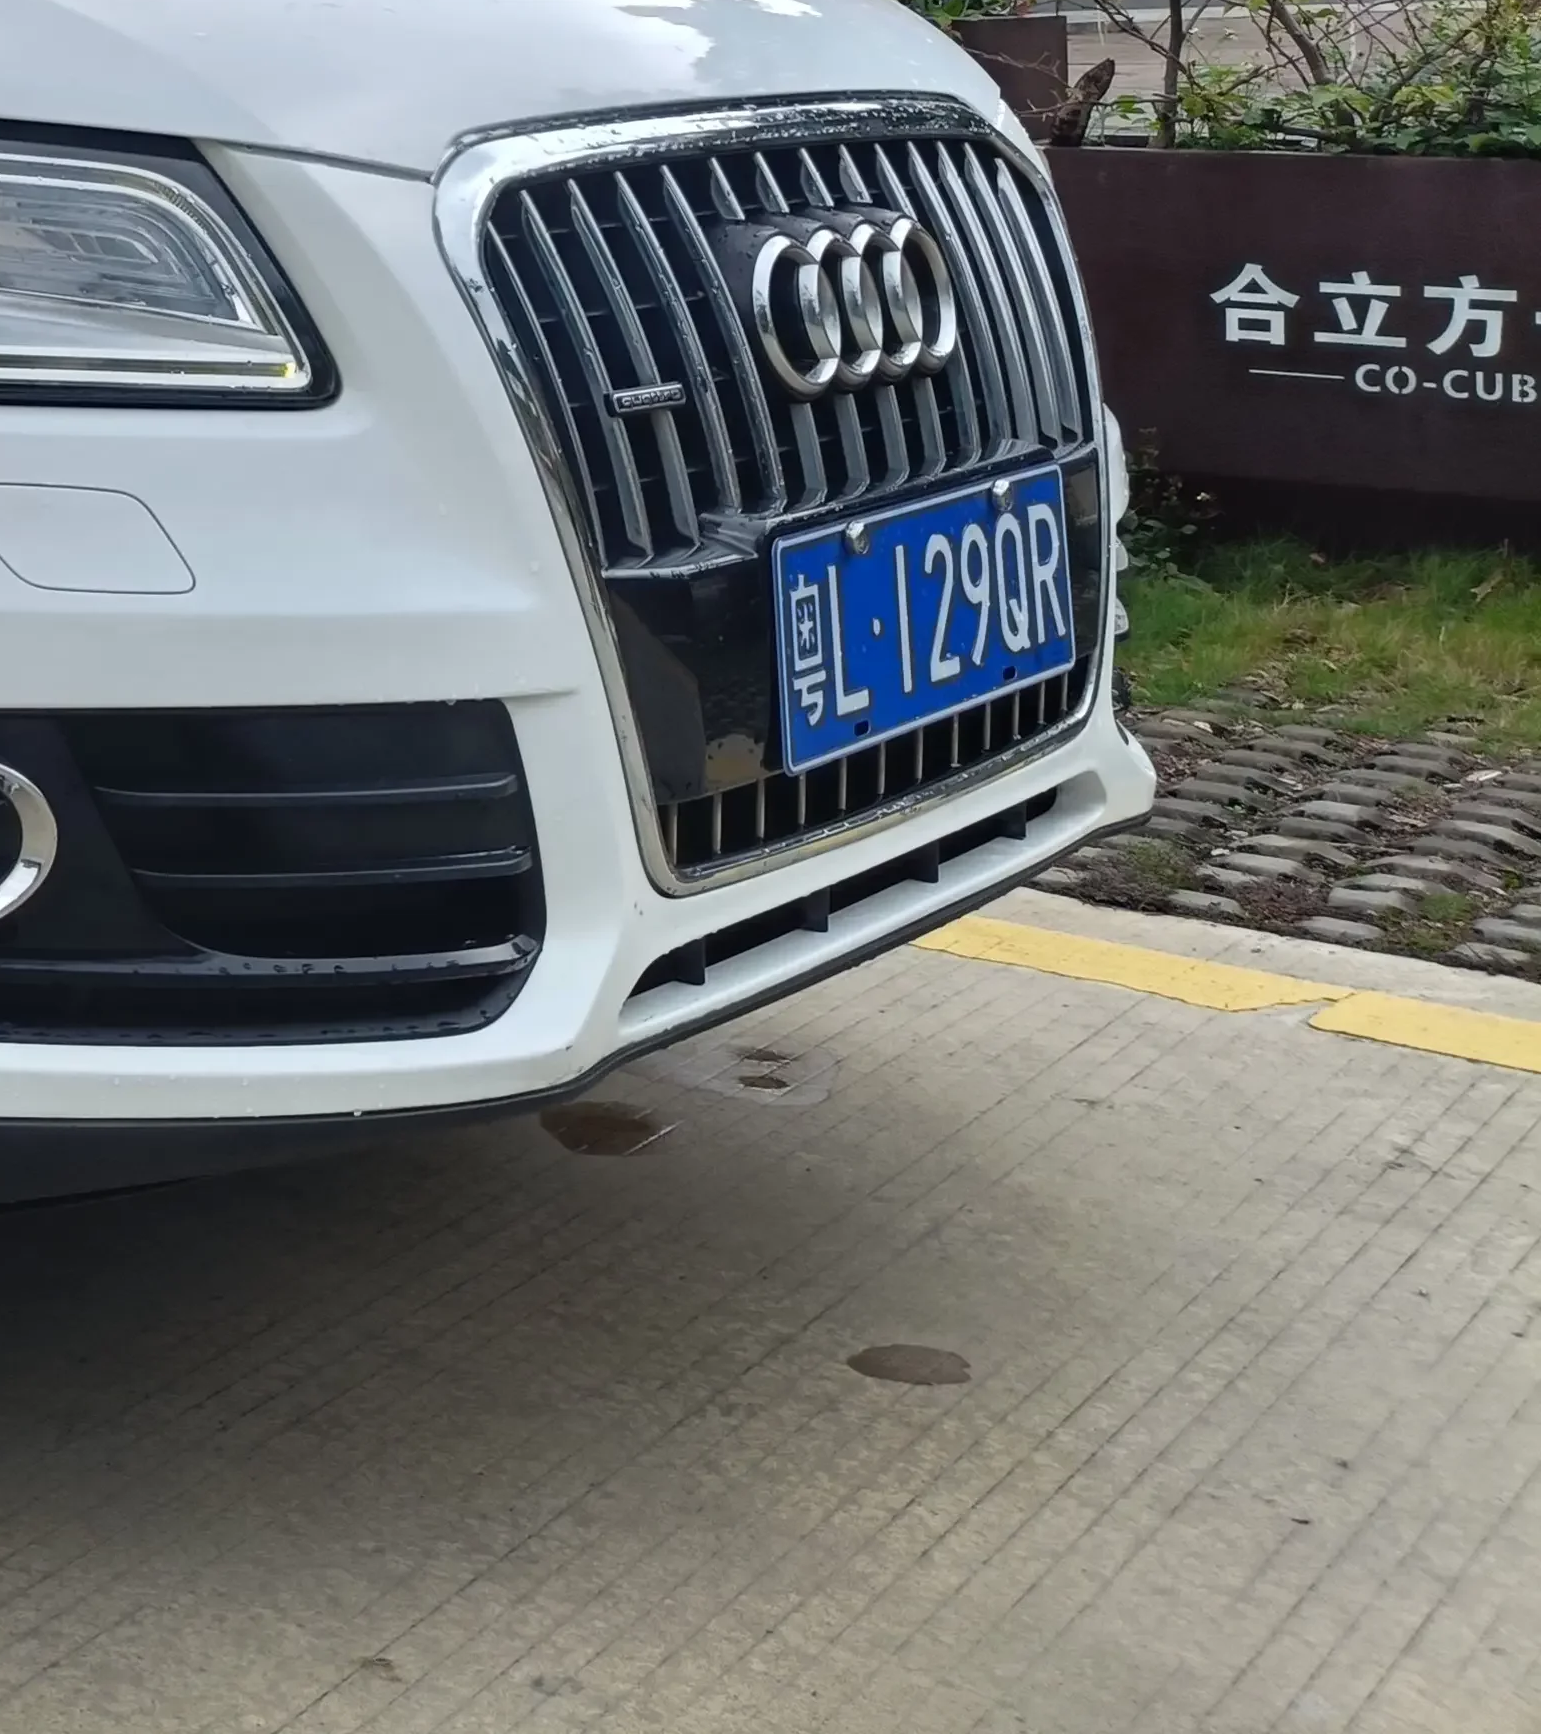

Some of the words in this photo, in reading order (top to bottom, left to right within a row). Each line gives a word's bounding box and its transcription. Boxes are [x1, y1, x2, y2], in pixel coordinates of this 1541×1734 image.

[1209, 263, 1541, 358] 合立方
[1355, 363, 1538, 404] CO-CUB
